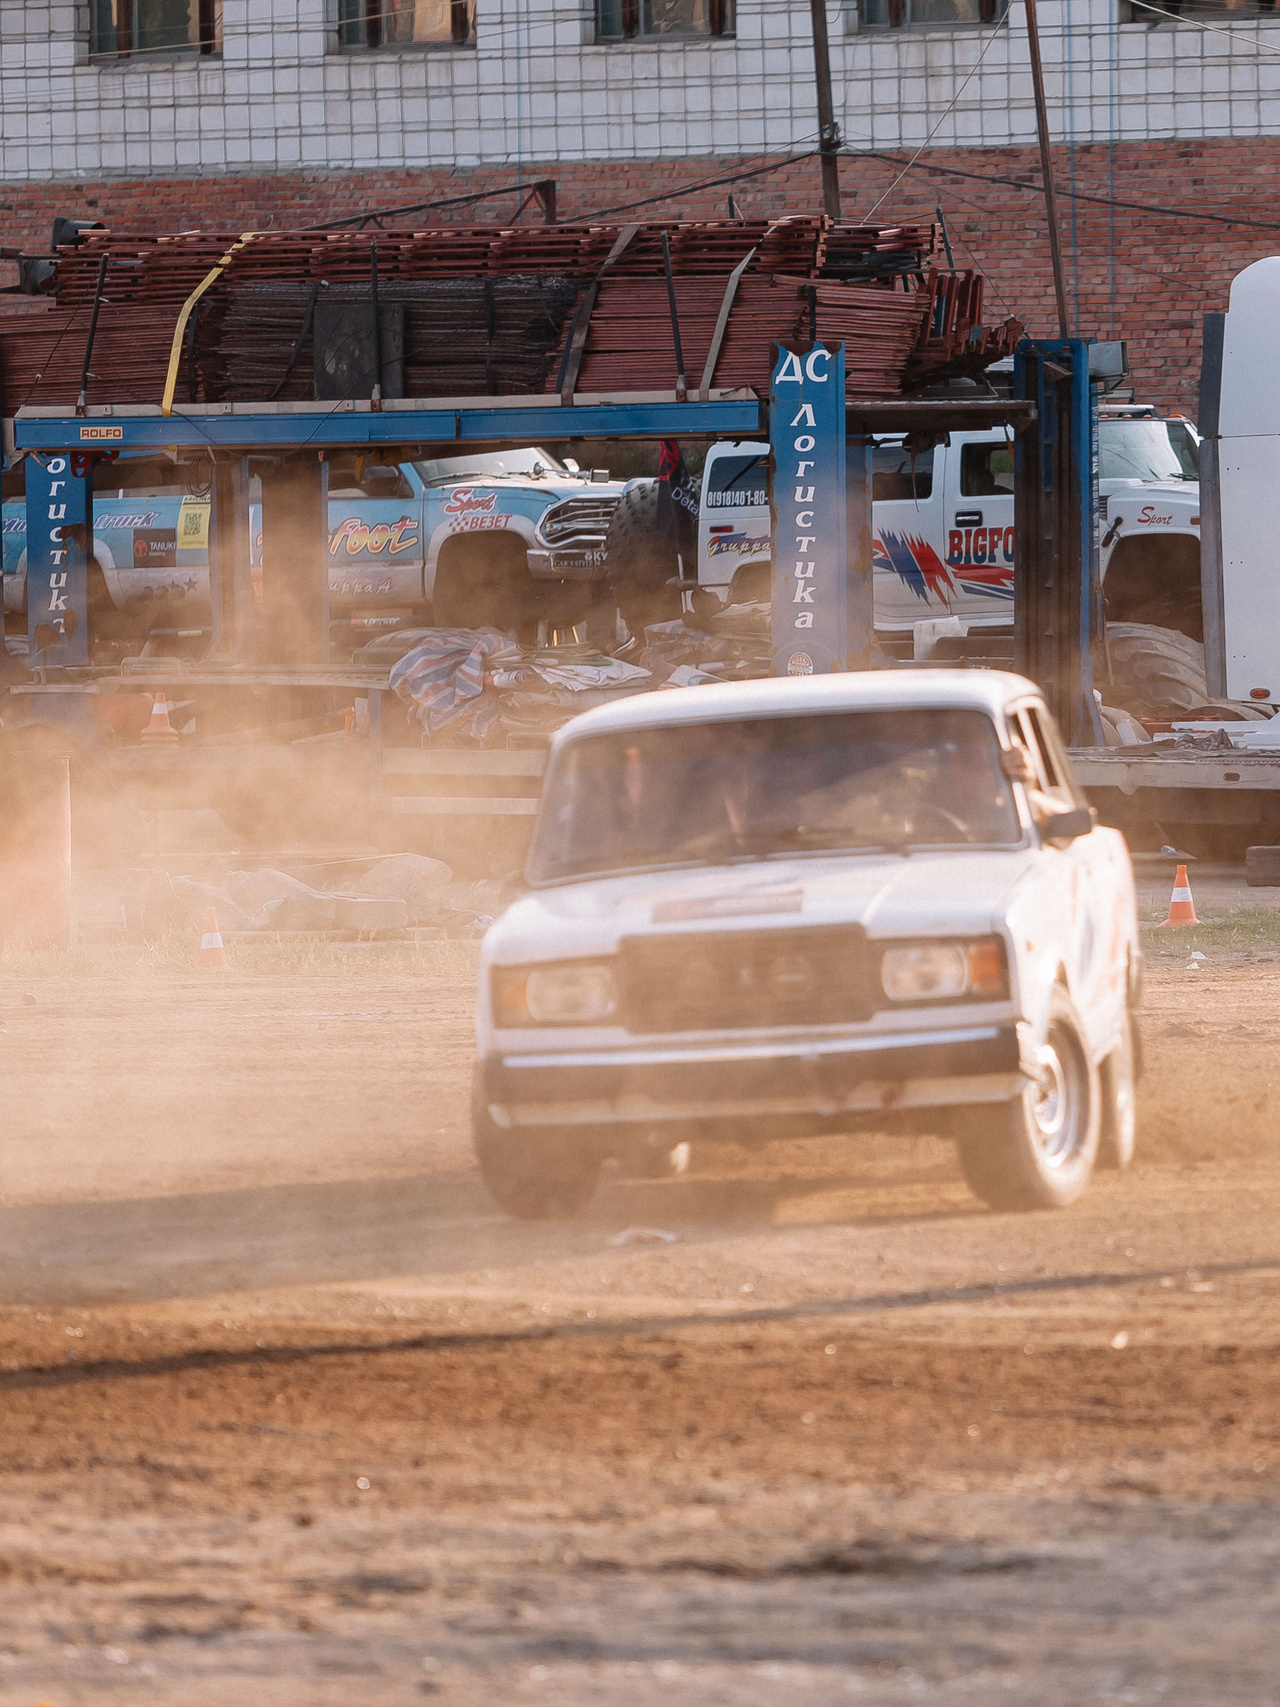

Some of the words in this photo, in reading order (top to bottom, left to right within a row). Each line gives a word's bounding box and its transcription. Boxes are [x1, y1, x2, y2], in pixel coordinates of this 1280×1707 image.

[775, 349, 832, 385] ДС
[81, 429, 122, 438] ROLFO
[445, 488, 497, 516] Sport
[93, 510, 161, 531] truck
[1137, 506, 1173, 526] Sport
[150, 541, 176, 551] TANUKI
[707, 536, 771, 558] Gruppa
